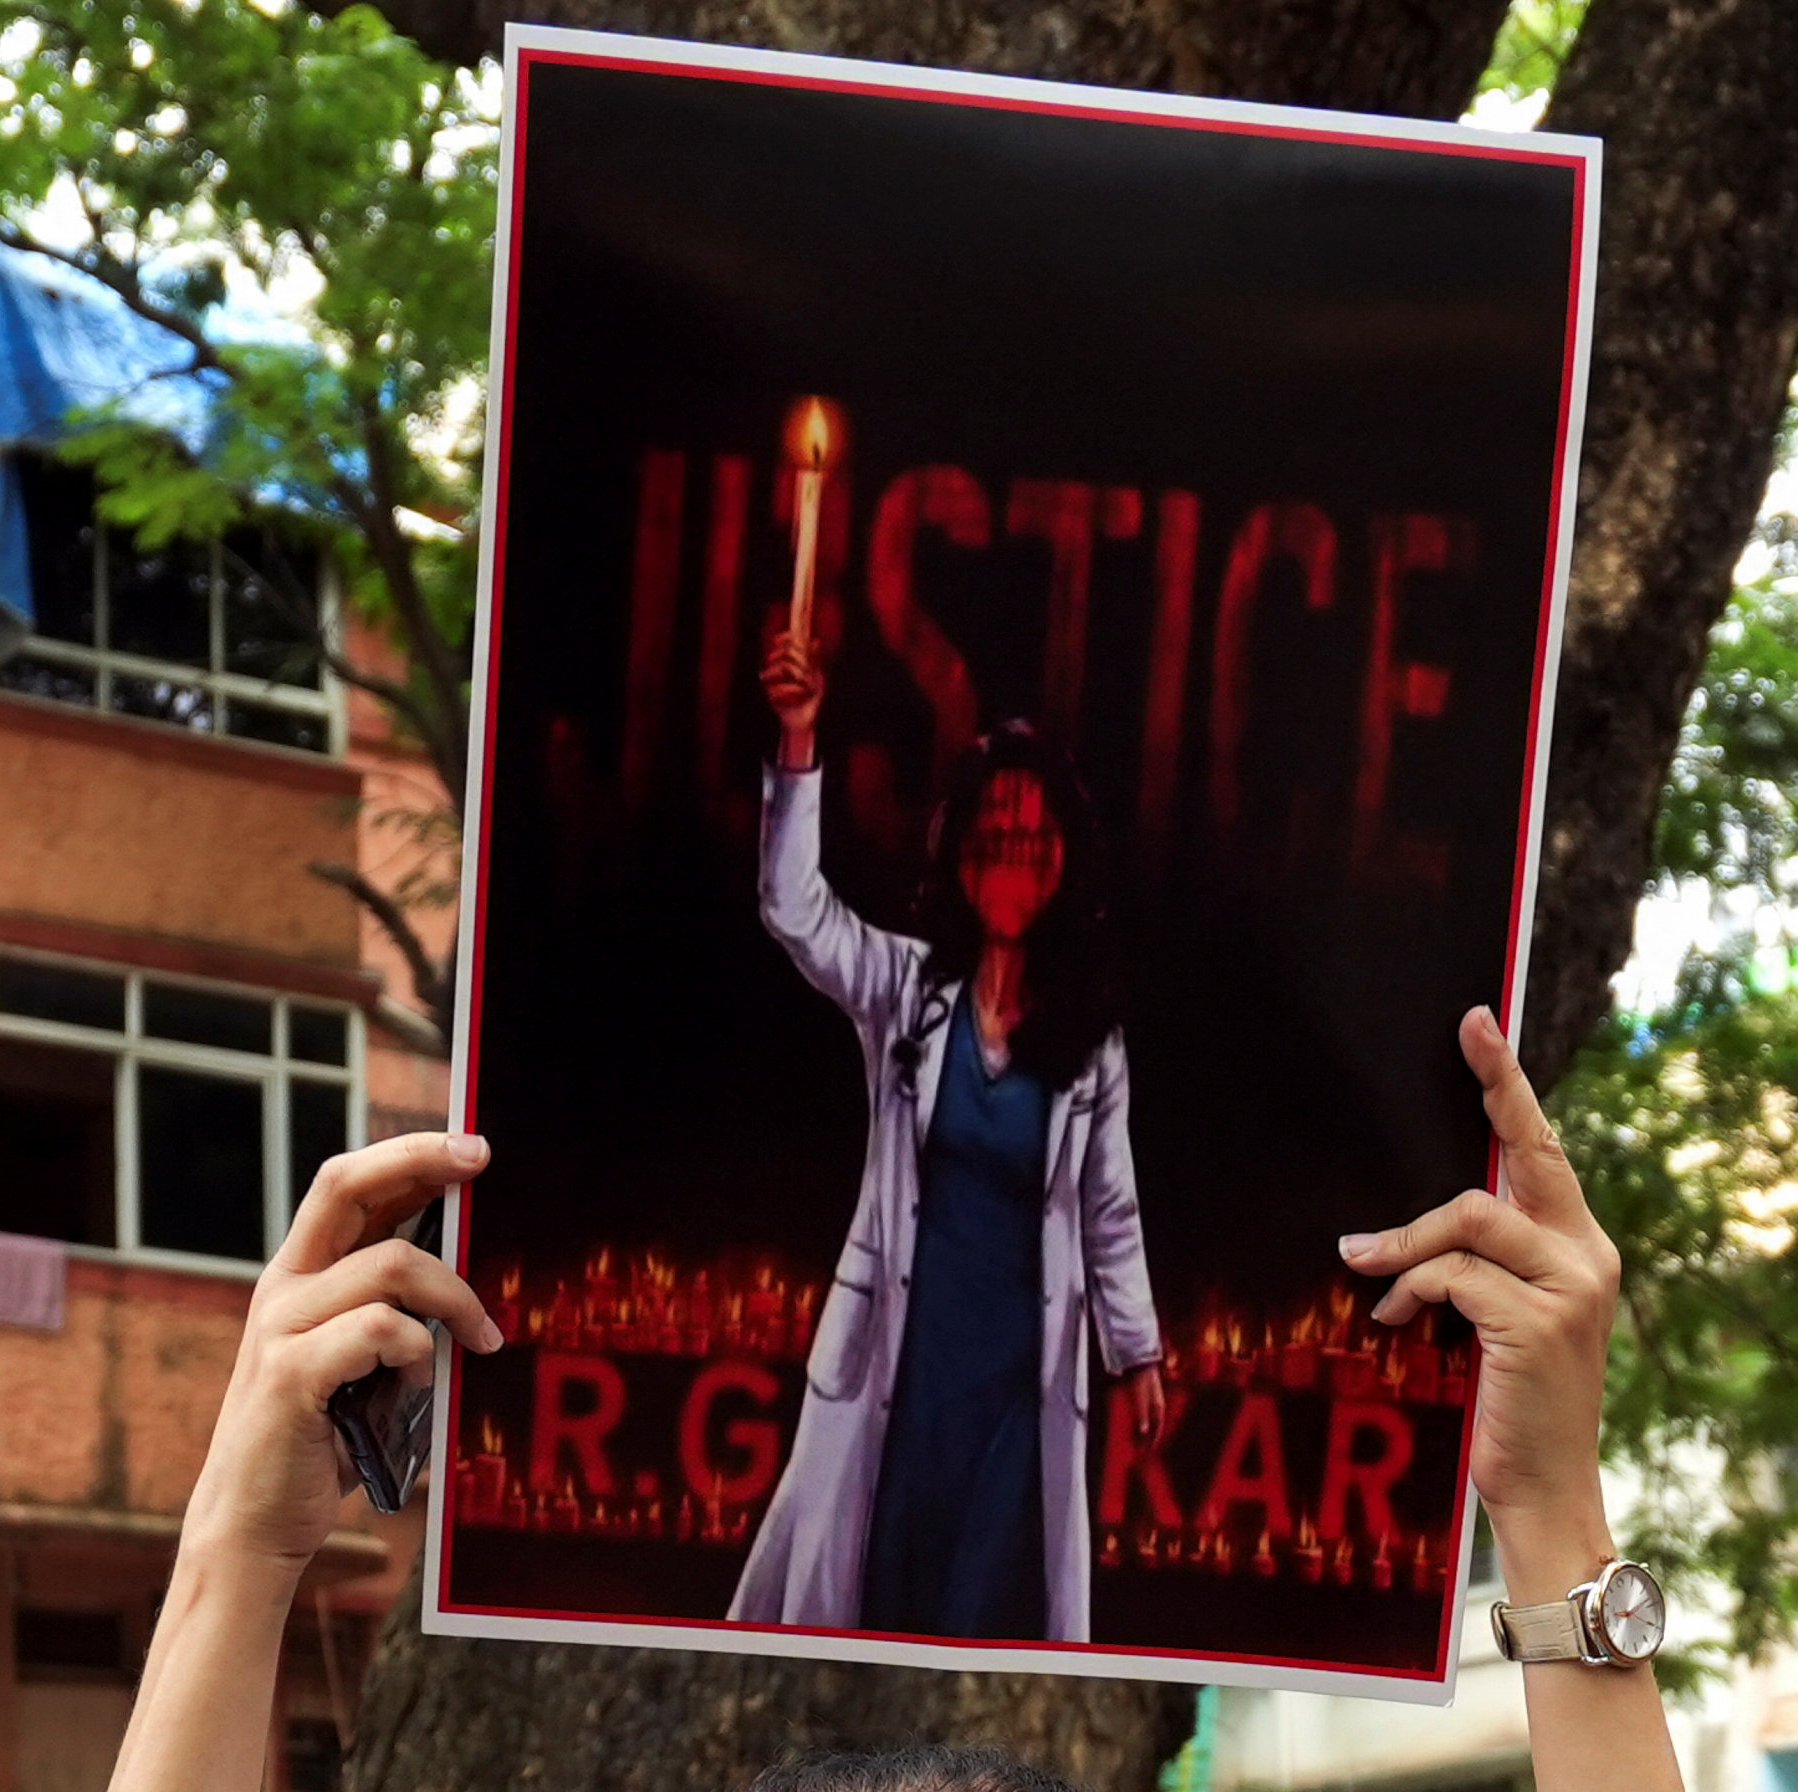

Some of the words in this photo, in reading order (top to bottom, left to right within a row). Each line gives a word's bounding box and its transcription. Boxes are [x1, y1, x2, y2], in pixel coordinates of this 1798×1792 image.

[539, 446, 1475, 892] JUSTICE
[529, 1352, 781, 1505] R.G
[1098, 1388, 1415, 1542] KAR
